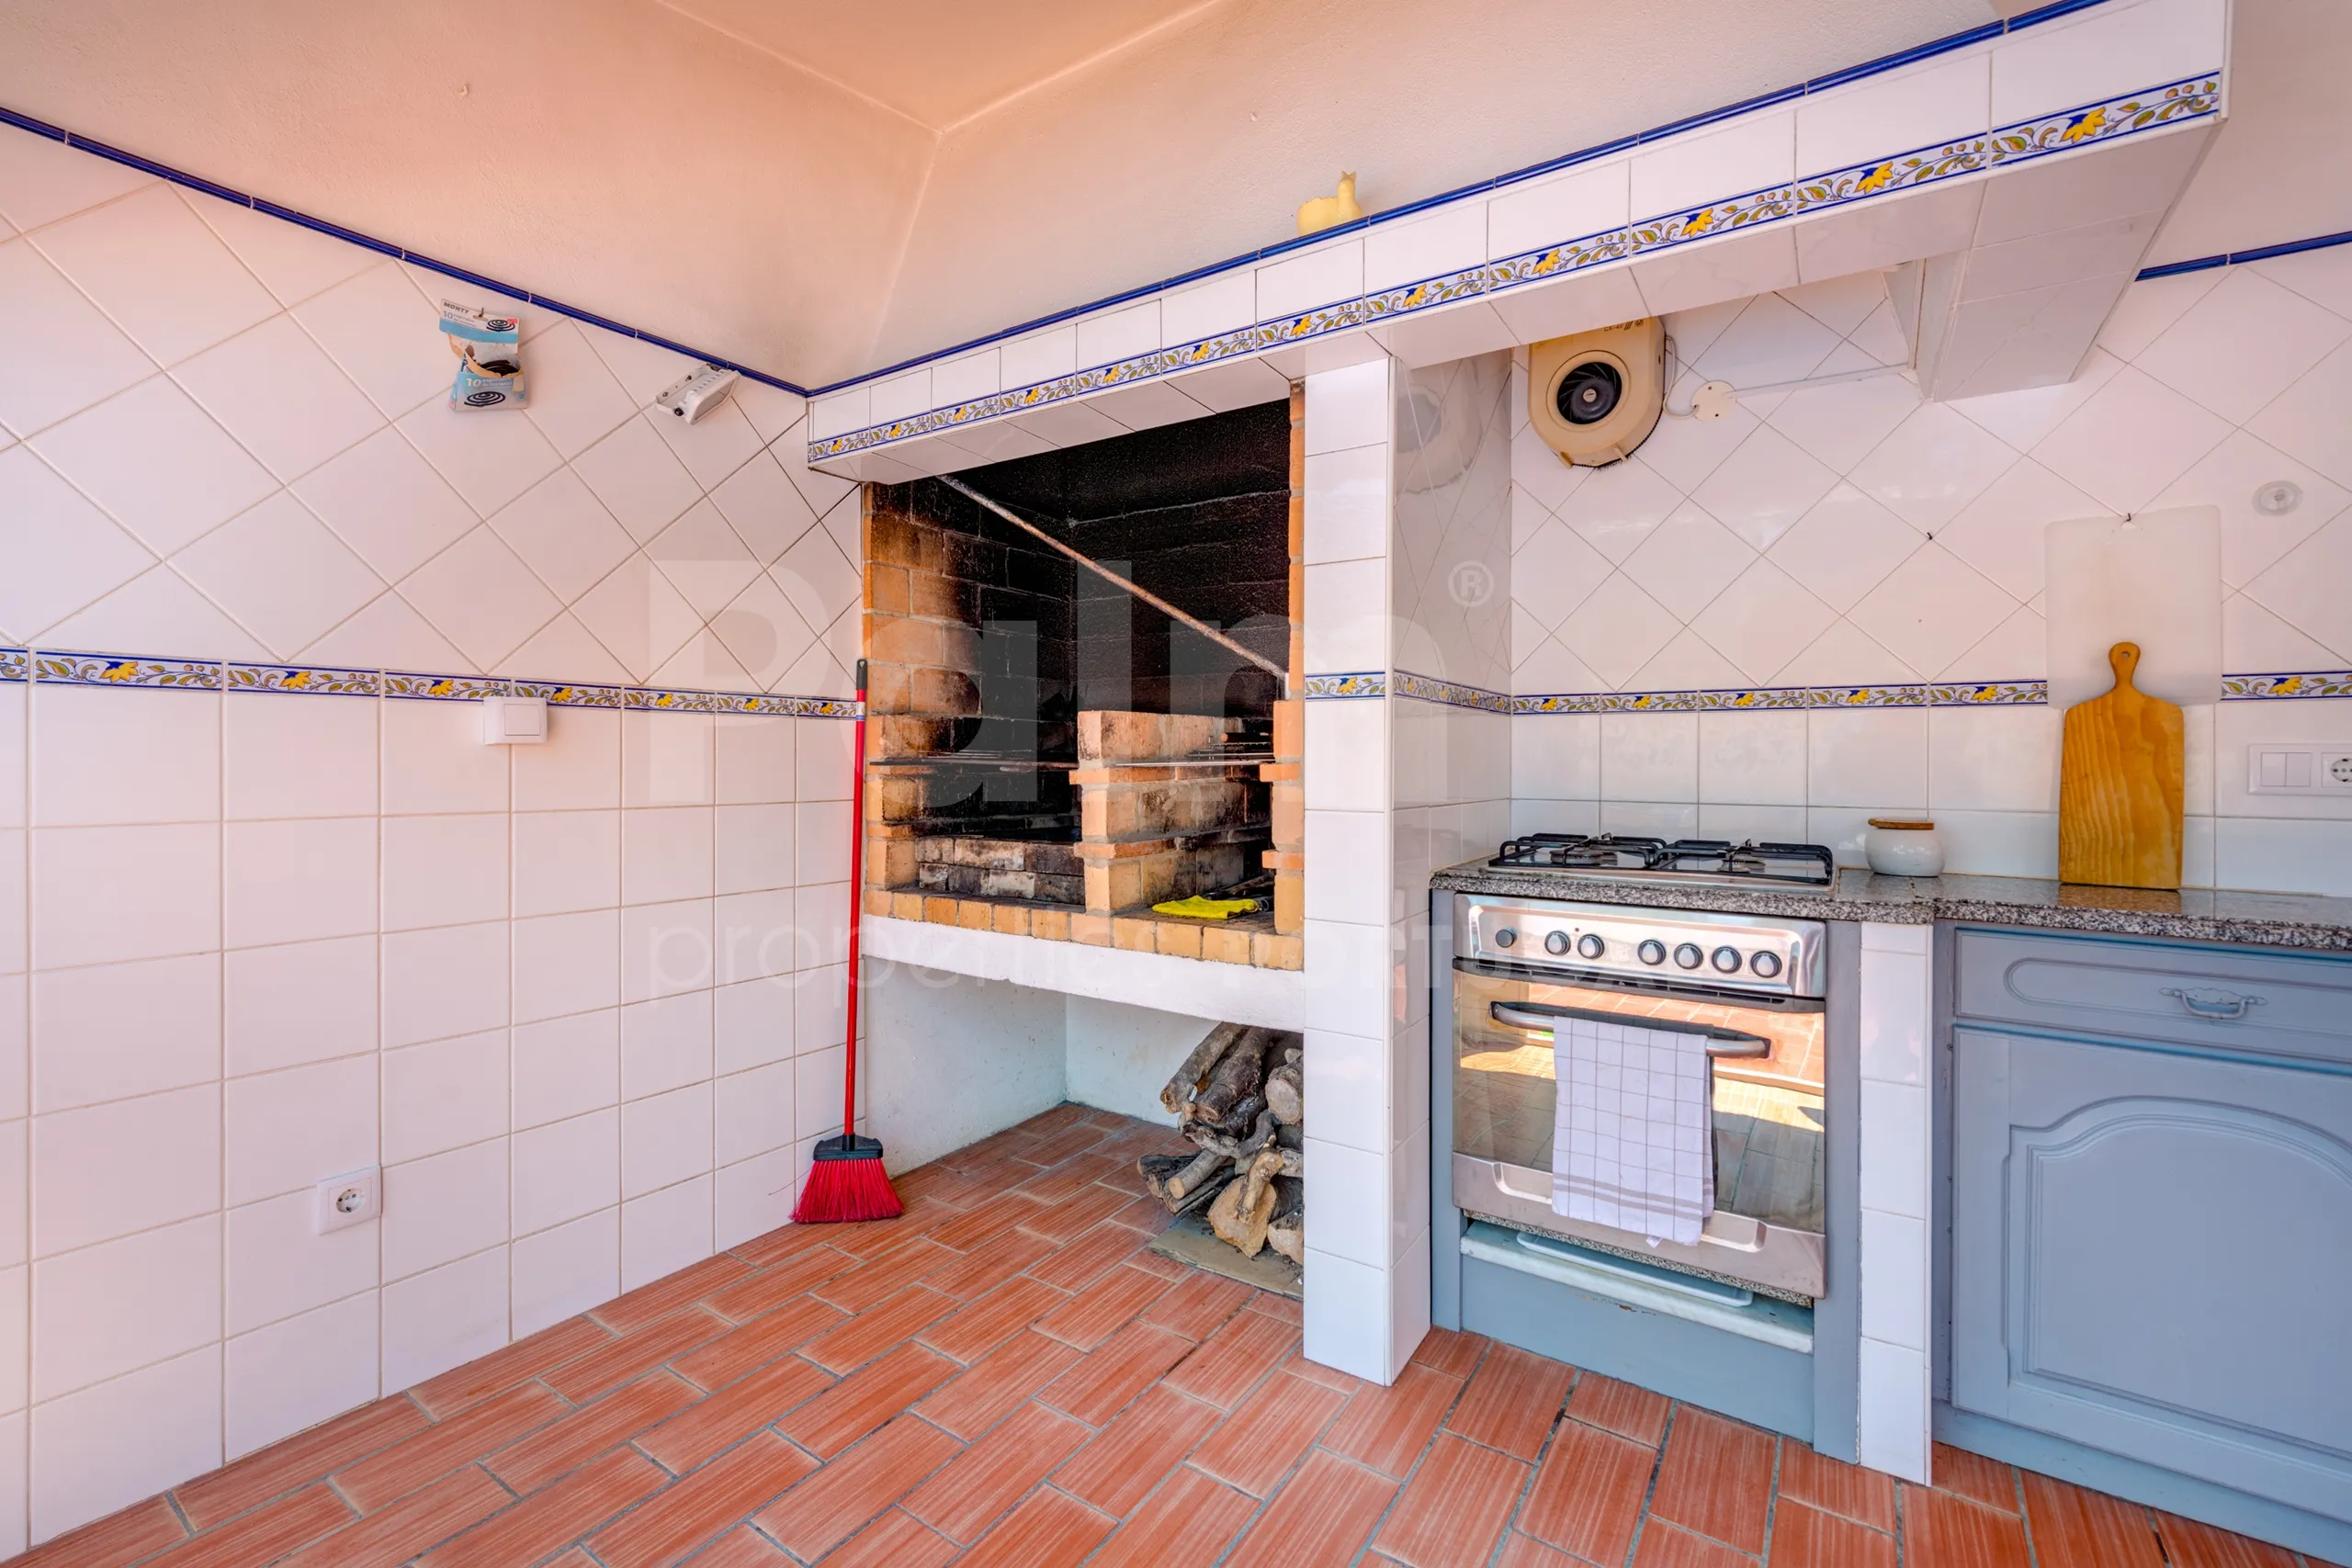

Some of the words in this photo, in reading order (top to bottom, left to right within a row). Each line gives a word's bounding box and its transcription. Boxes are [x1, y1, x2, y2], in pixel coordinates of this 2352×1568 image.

[443, 301, 470, 314] MONTY
[443, 310, 454, 320] 10
[466, 378, 482, 388] 10
